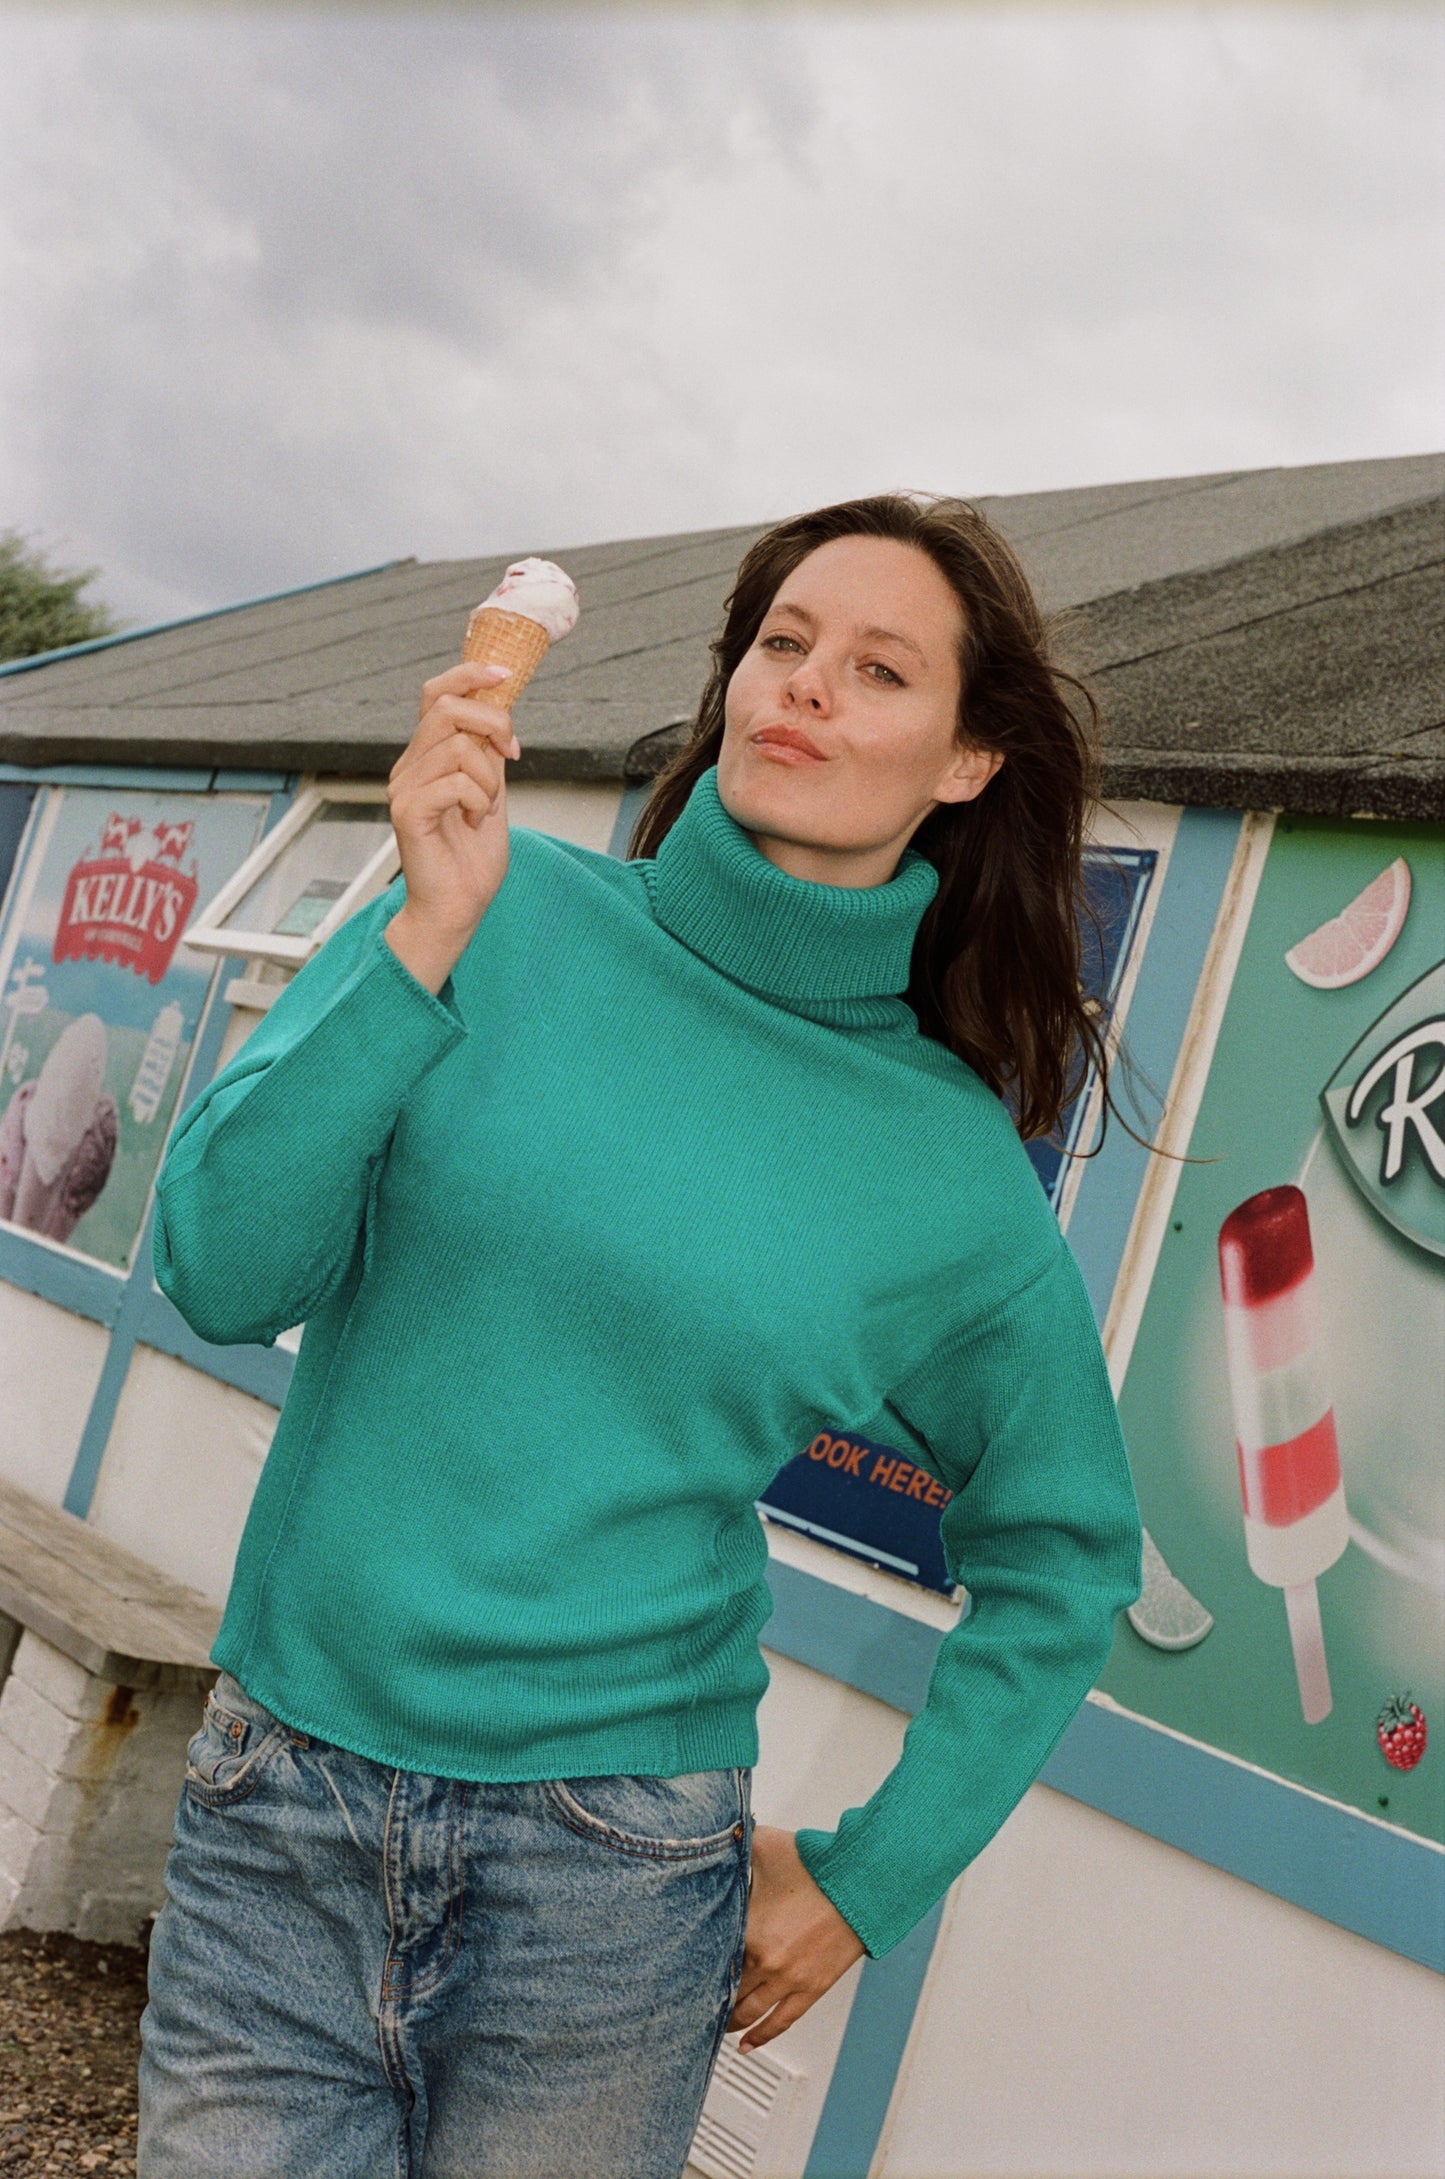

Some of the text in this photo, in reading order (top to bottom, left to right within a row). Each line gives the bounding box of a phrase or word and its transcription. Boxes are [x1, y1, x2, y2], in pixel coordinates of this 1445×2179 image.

[69, 873, 184, 942] KELLY'S
[802, 1432, 954, 1510] OOK HERE!
